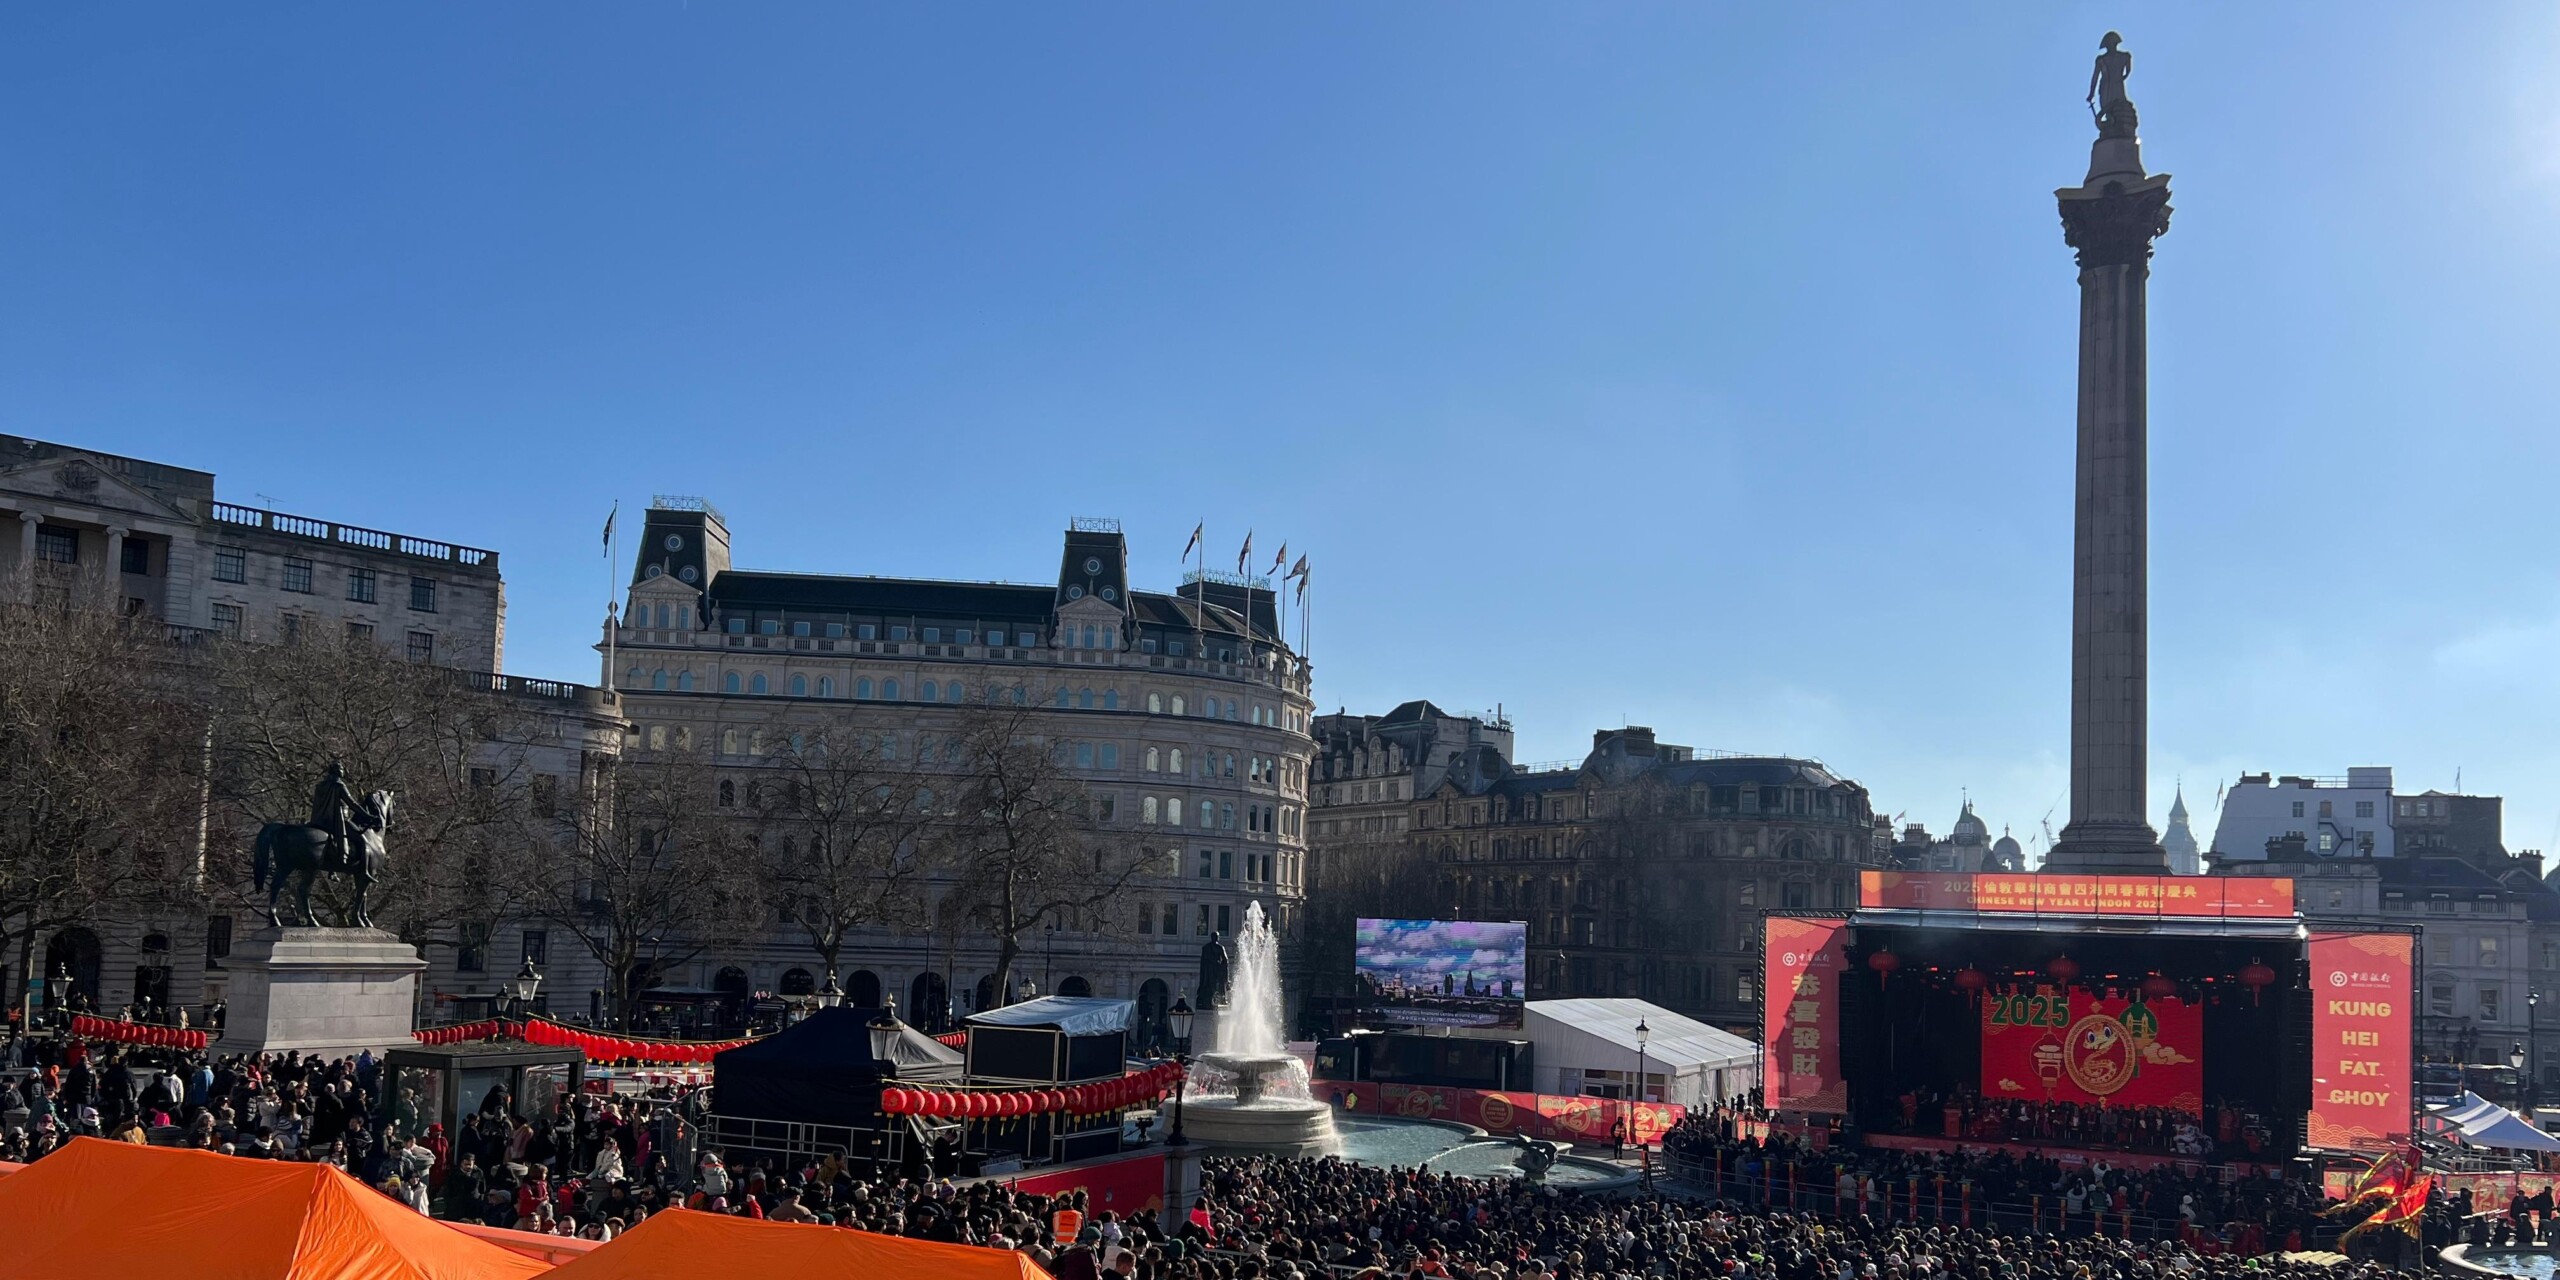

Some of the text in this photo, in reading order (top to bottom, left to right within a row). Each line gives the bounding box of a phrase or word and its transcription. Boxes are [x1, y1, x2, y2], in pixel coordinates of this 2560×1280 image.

[1944, 880, 1980, 893] 2025
[1967, 896, 2164, 909] CHINESE NEW YEAR LONDON 2025
[1990, 993, 2071, 1029] 2025
[2329, 1000, 2392, 1017] KUNG
[2342, 1031, 2379, 1046] HEI
[2339, 1060, 2380, 1076] FAT
